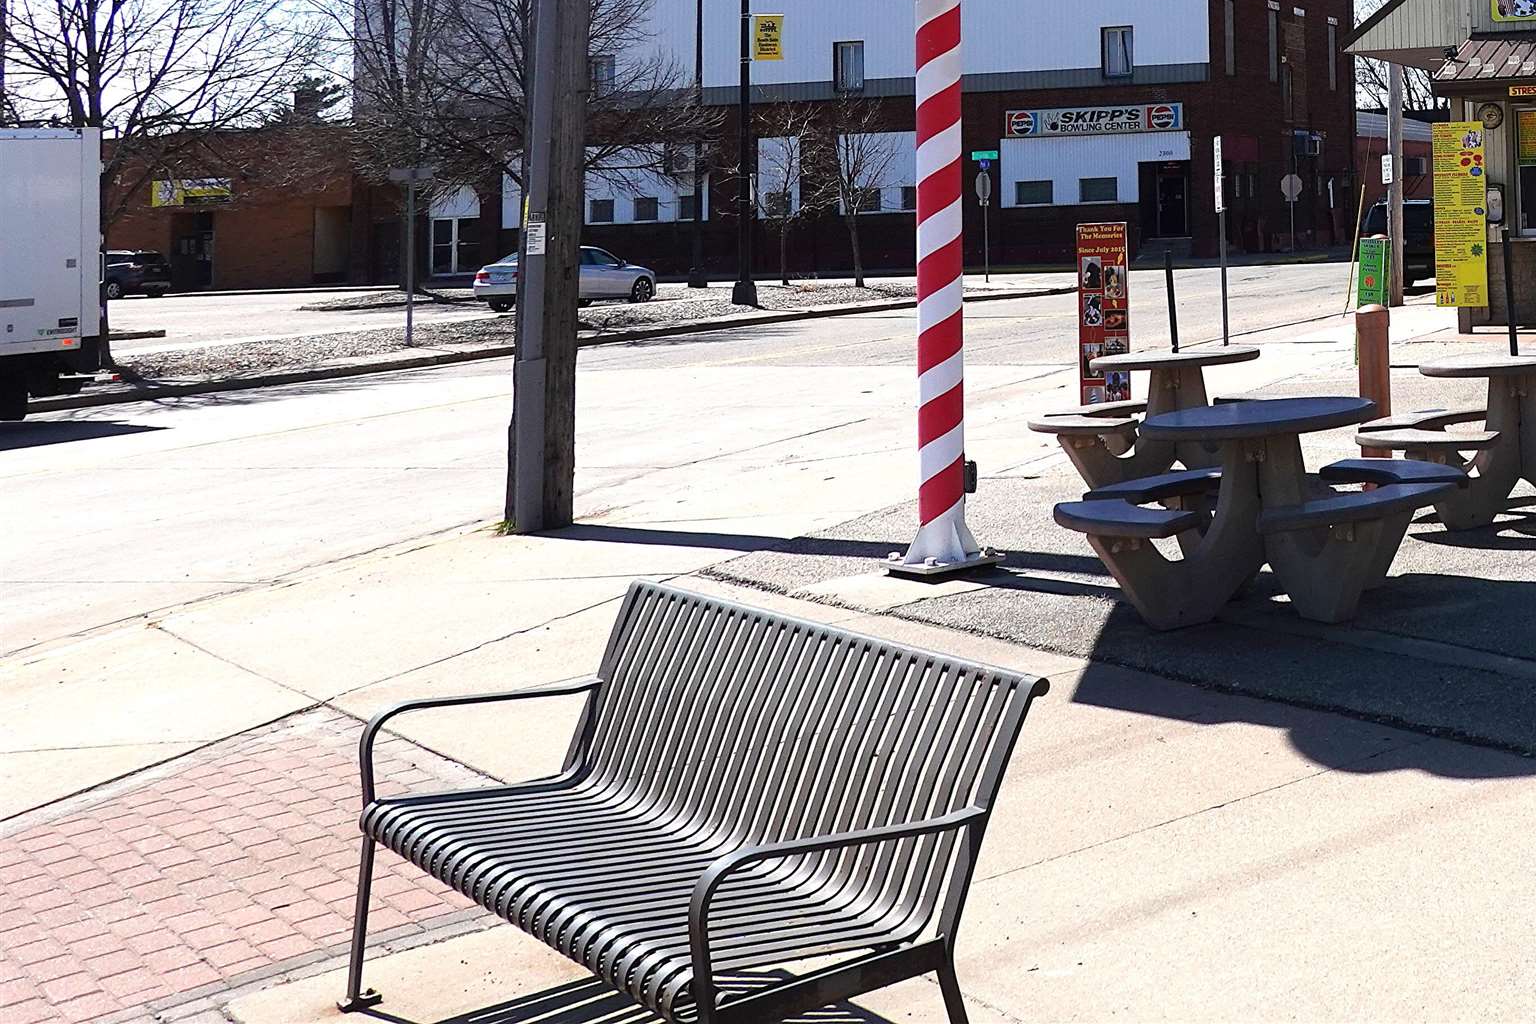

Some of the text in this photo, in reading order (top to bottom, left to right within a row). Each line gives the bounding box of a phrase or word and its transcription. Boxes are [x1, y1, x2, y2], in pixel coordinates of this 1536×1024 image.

[1060, 108, 1141, 123] SKIPP'S
[1151, 113, 1174, 121] PEPSI
[1060, 120, 1141, 133] BOWLING CENTER
[1096, 246, 1110, 254] July
